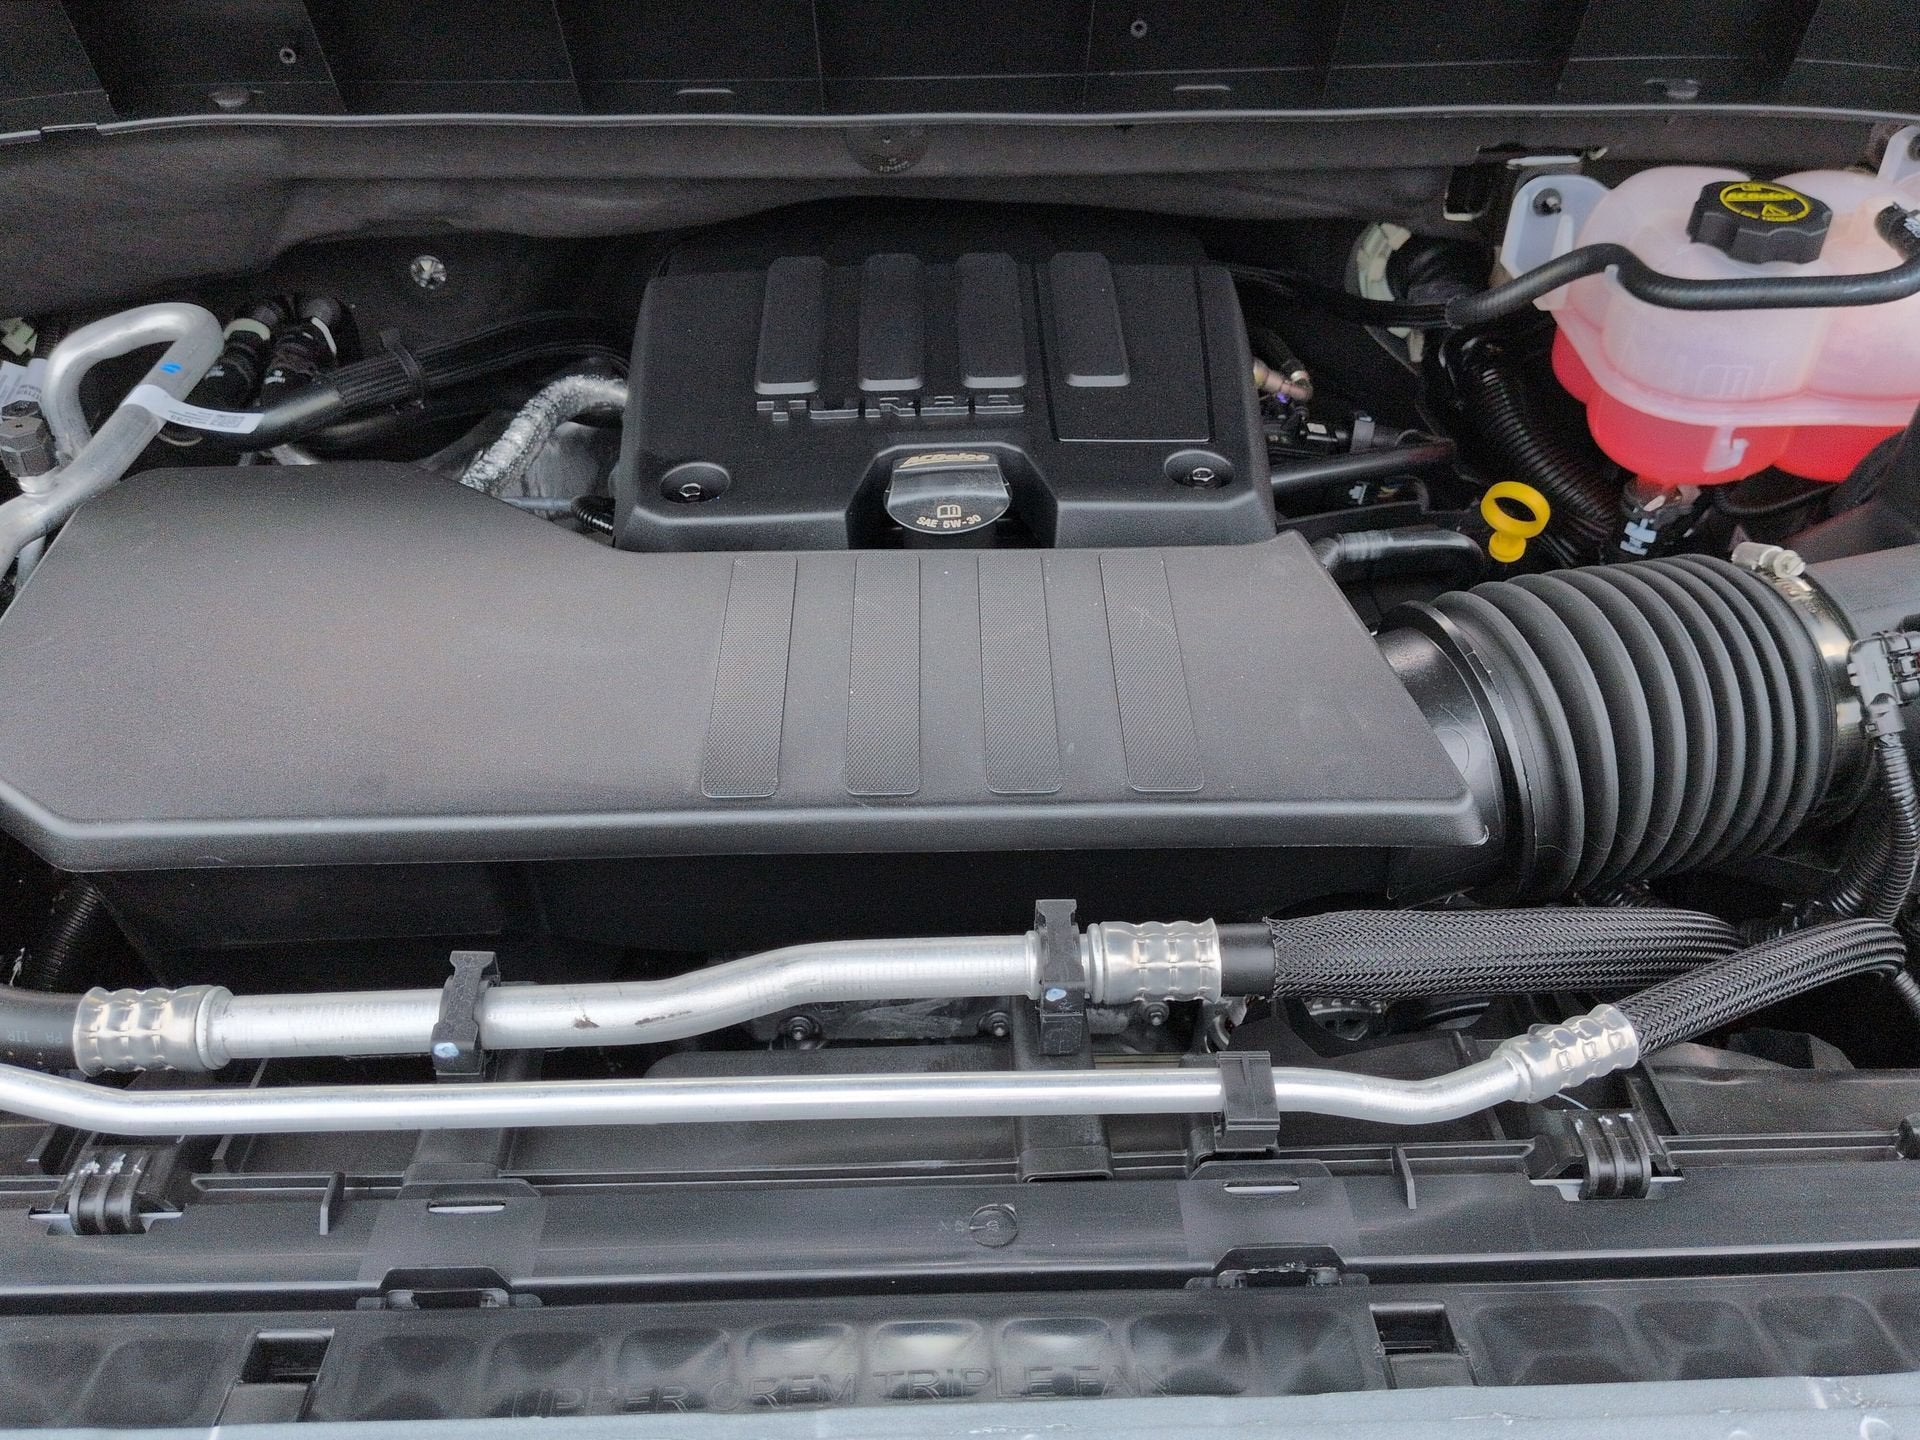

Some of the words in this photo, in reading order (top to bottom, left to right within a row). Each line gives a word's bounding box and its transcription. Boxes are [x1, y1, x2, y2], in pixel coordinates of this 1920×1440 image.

[916, 516, 938, 528] SAE
[943, 515, 982, 529] 5W-30
[873, 1366, 1053, 1401] TRIPLE
[1072, 1364, 1172, 1398] FAN
